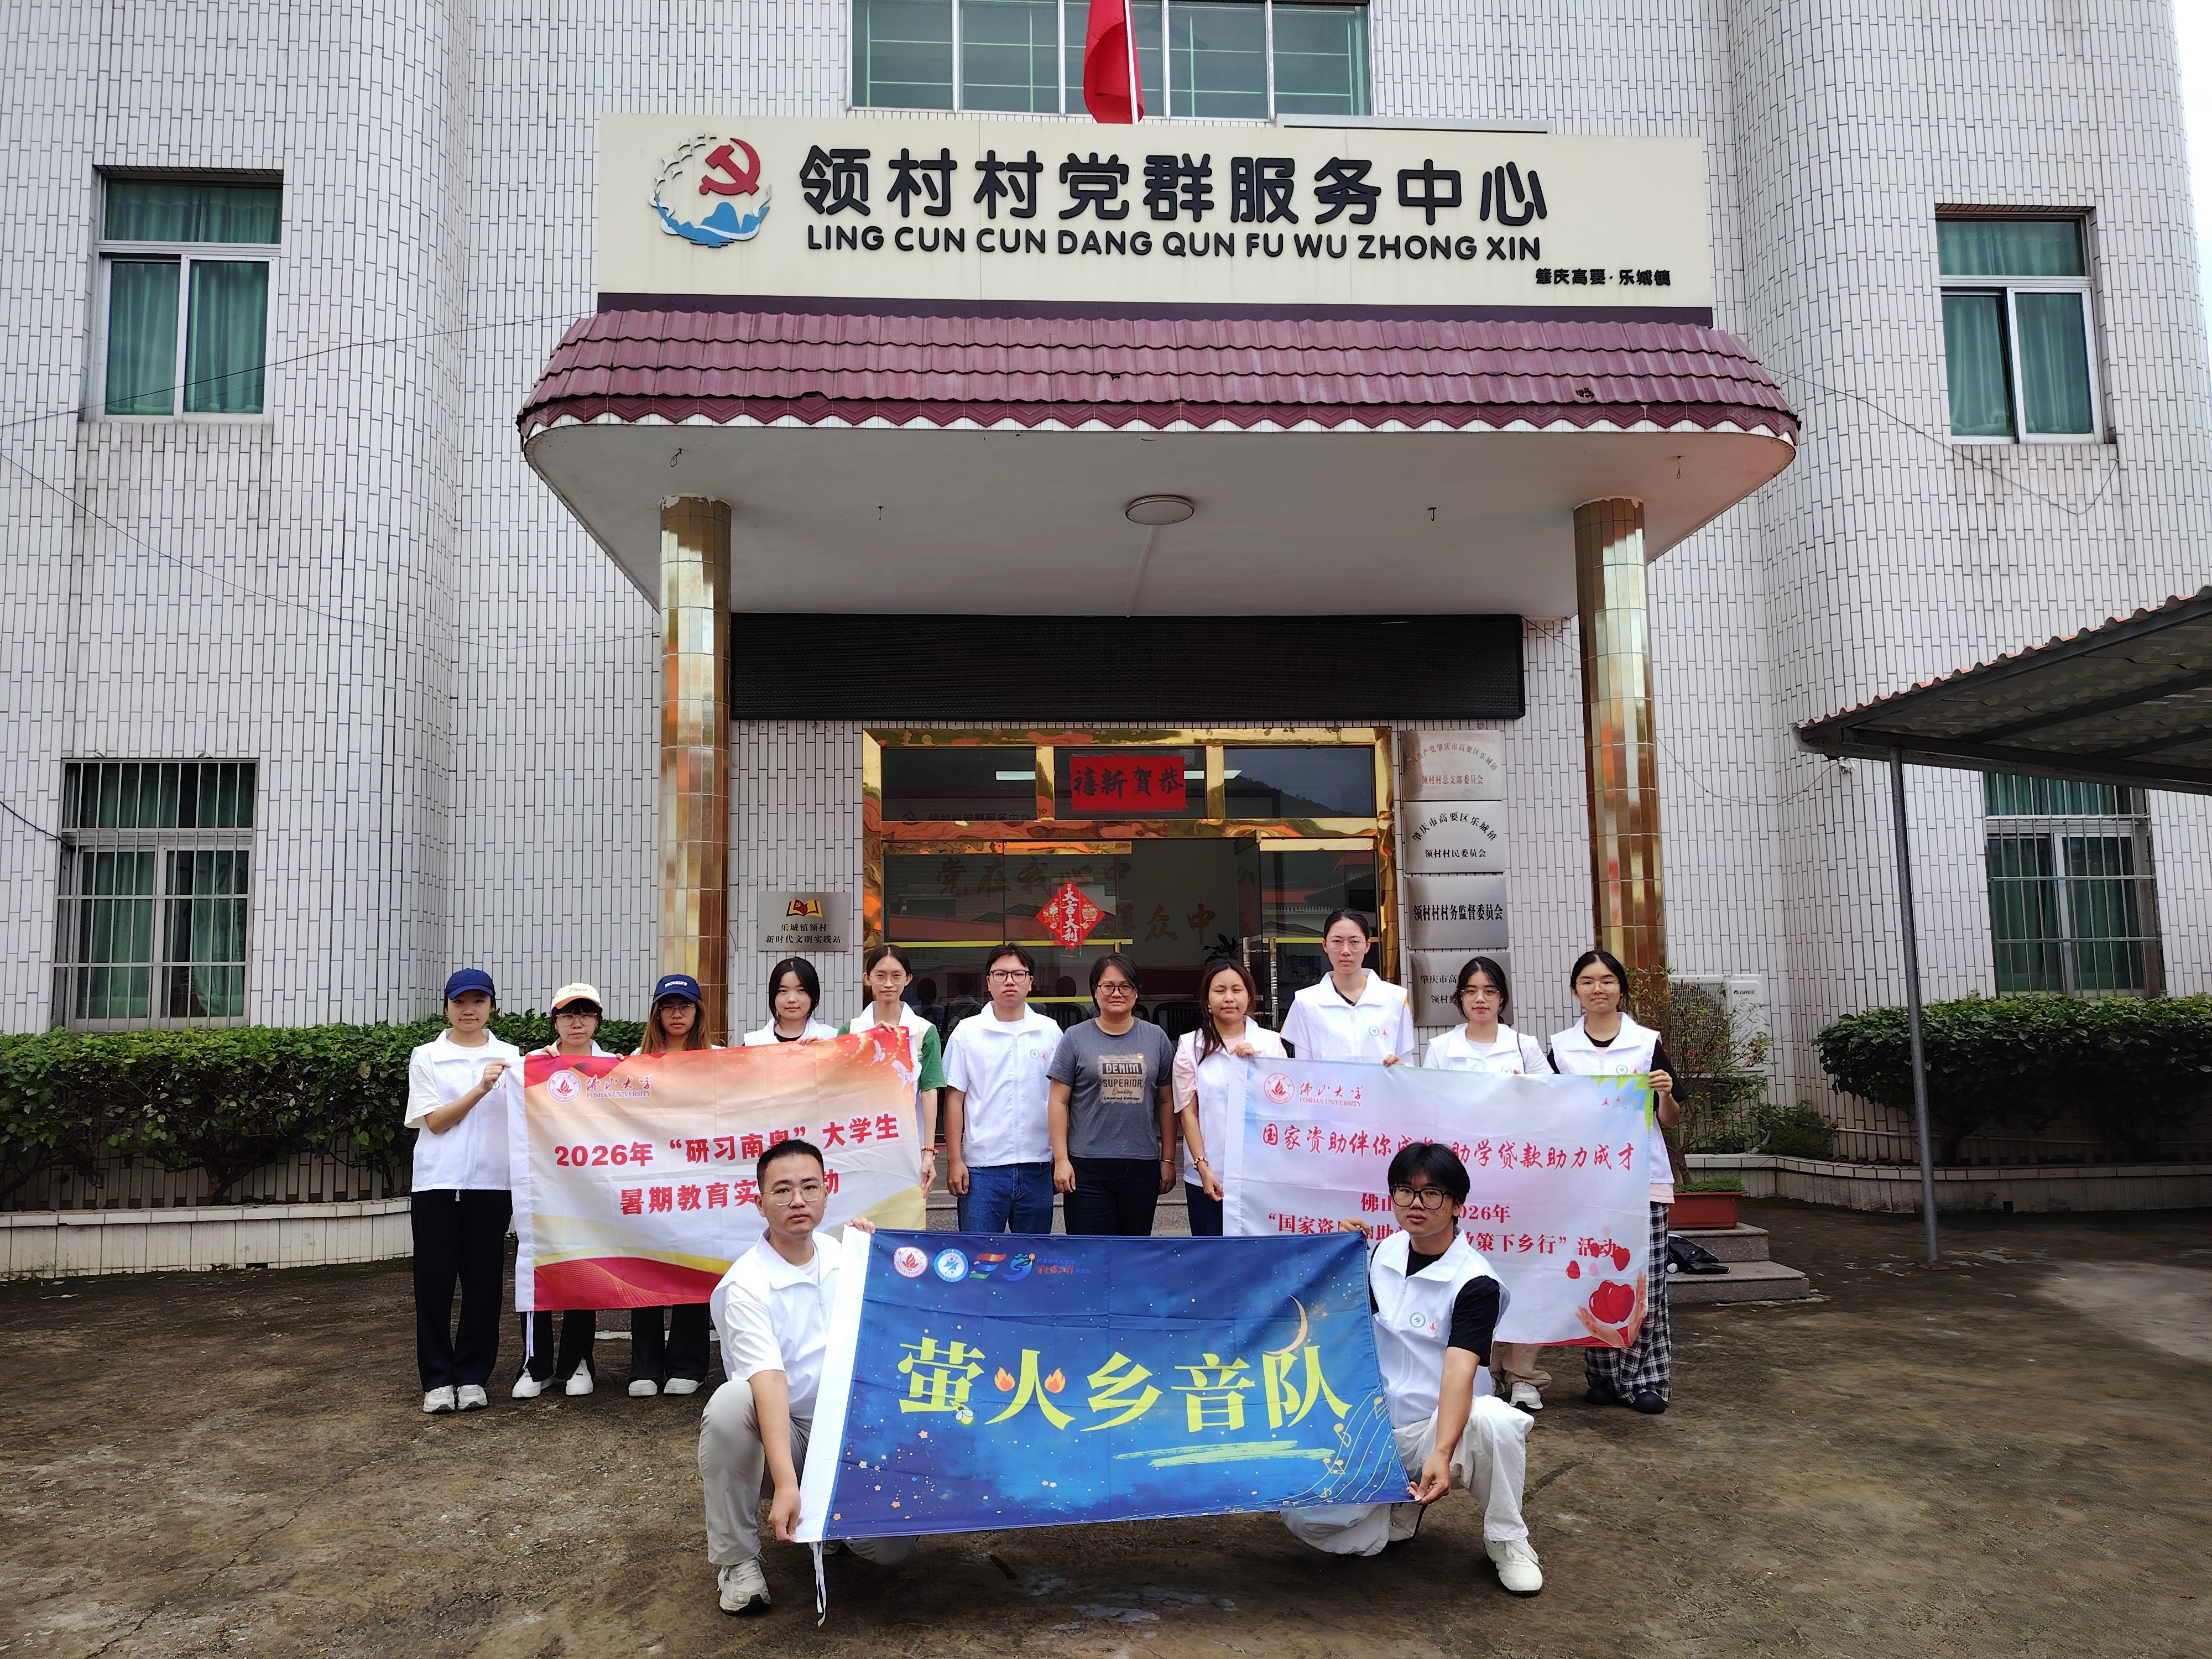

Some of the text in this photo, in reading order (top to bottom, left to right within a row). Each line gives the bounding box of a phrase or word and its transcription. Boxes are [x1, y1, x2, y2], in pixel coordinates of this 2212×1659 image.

[800, 144, 1547, 226] 领村村党群服务中心
[808, 225, 1540, 261] LING CUN CUN DANG QUN FU WU ZHONG XIN
[1422, 775, 1484, 785] 领村村总支部委员会
[1412, 812, 1498, 842] 肇庆市高要区乐城镇
[1425, 849, 1486, 858] 领村村民委员会
[1061, 887, 1079, 942] 大吉大利
[1413, 904, 1503, 921] 领村村村务监督委员会
[781, 923, 828, 932] 乐城镇领村
[765, 935, 841, 944] 新时代文明实践站
[1420, 974, 1458, 984] 肇庆市高
[1105, 1063, 1139, 1073] DENIM
[586, 1074, 654, 1092] 佛山大学
[1103, 1079, 1142, 1088] SUPERIOR
[1300, 1081, 1364, 1099] 佛山大学
[1325, 1099, 1361, 1107] UNIVERSITY
